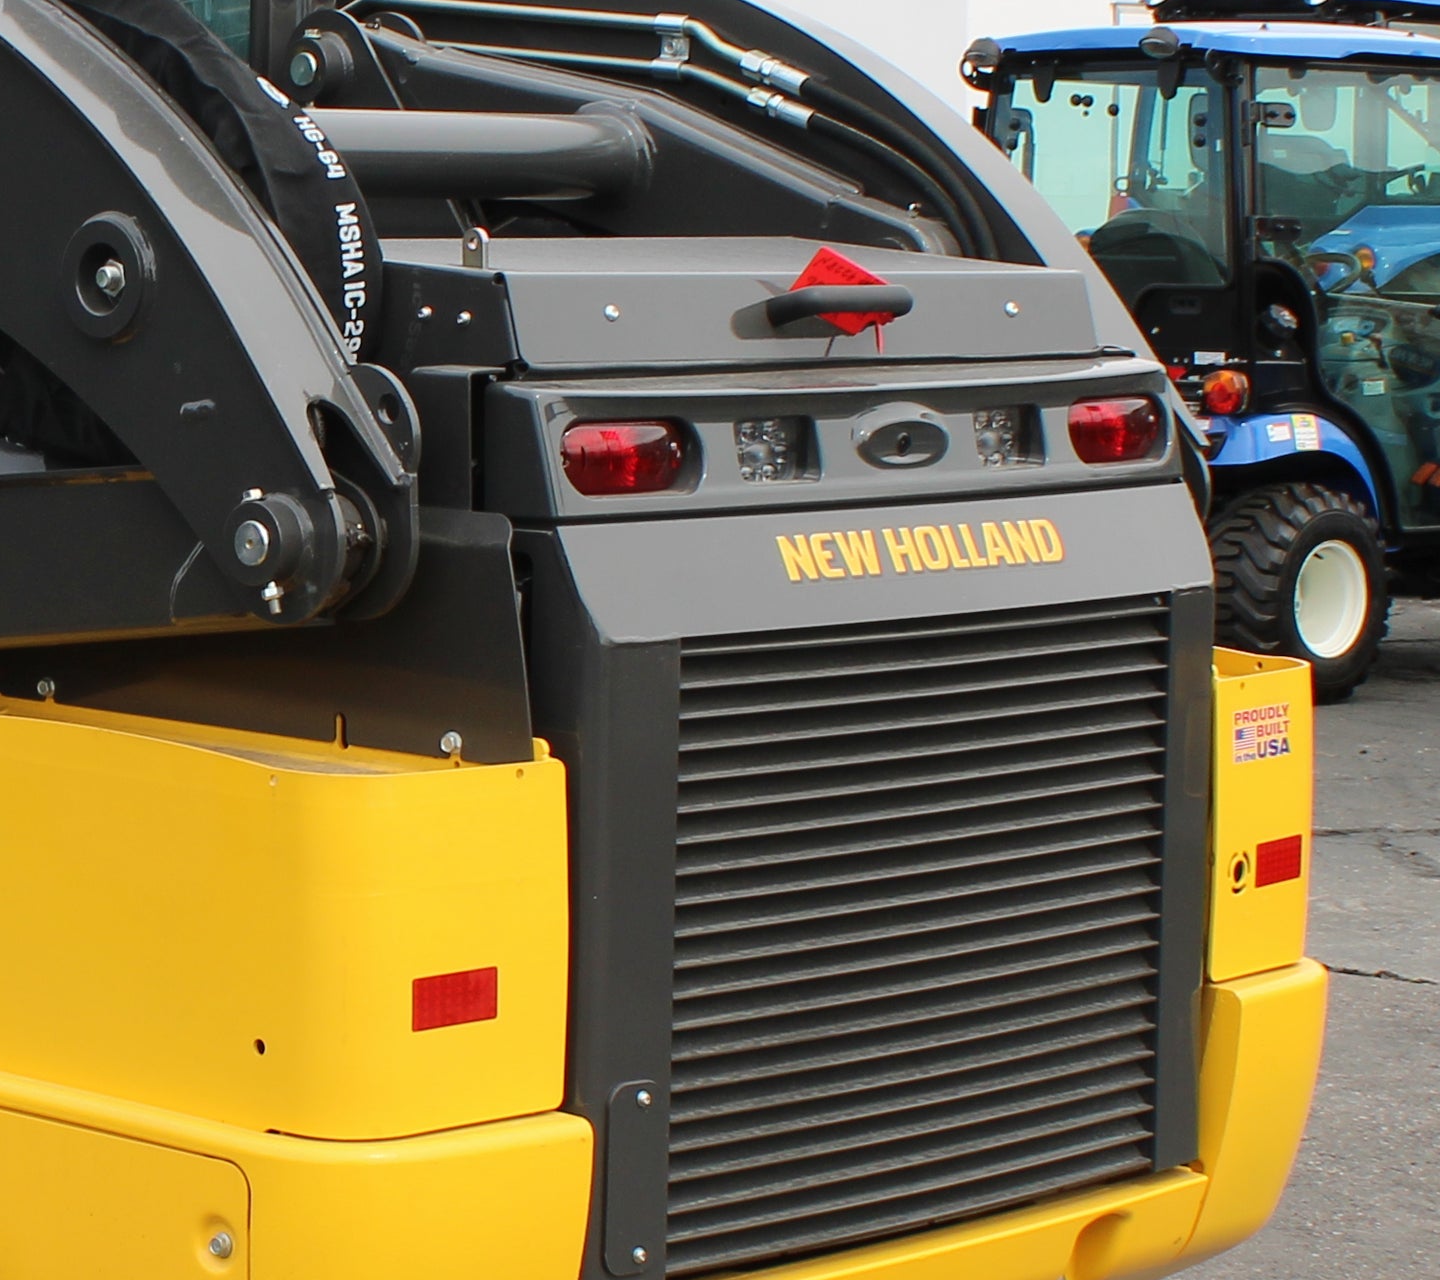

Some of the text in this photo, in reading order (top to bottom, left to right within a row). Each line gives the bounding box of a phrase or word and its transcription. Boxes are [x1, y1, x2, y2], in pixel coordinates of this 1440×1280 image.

[293, 114, 347, 180] HG-64
[335, 201, 367, 365] MSHA IC-29
[775, 519, 1065, 582] NEW HOLLAND
[1234, 704, 1289, 726] PROUDLY
[1256, 719, 1290, 738] BUILT
[1256, 736, 1291, 759] USA
